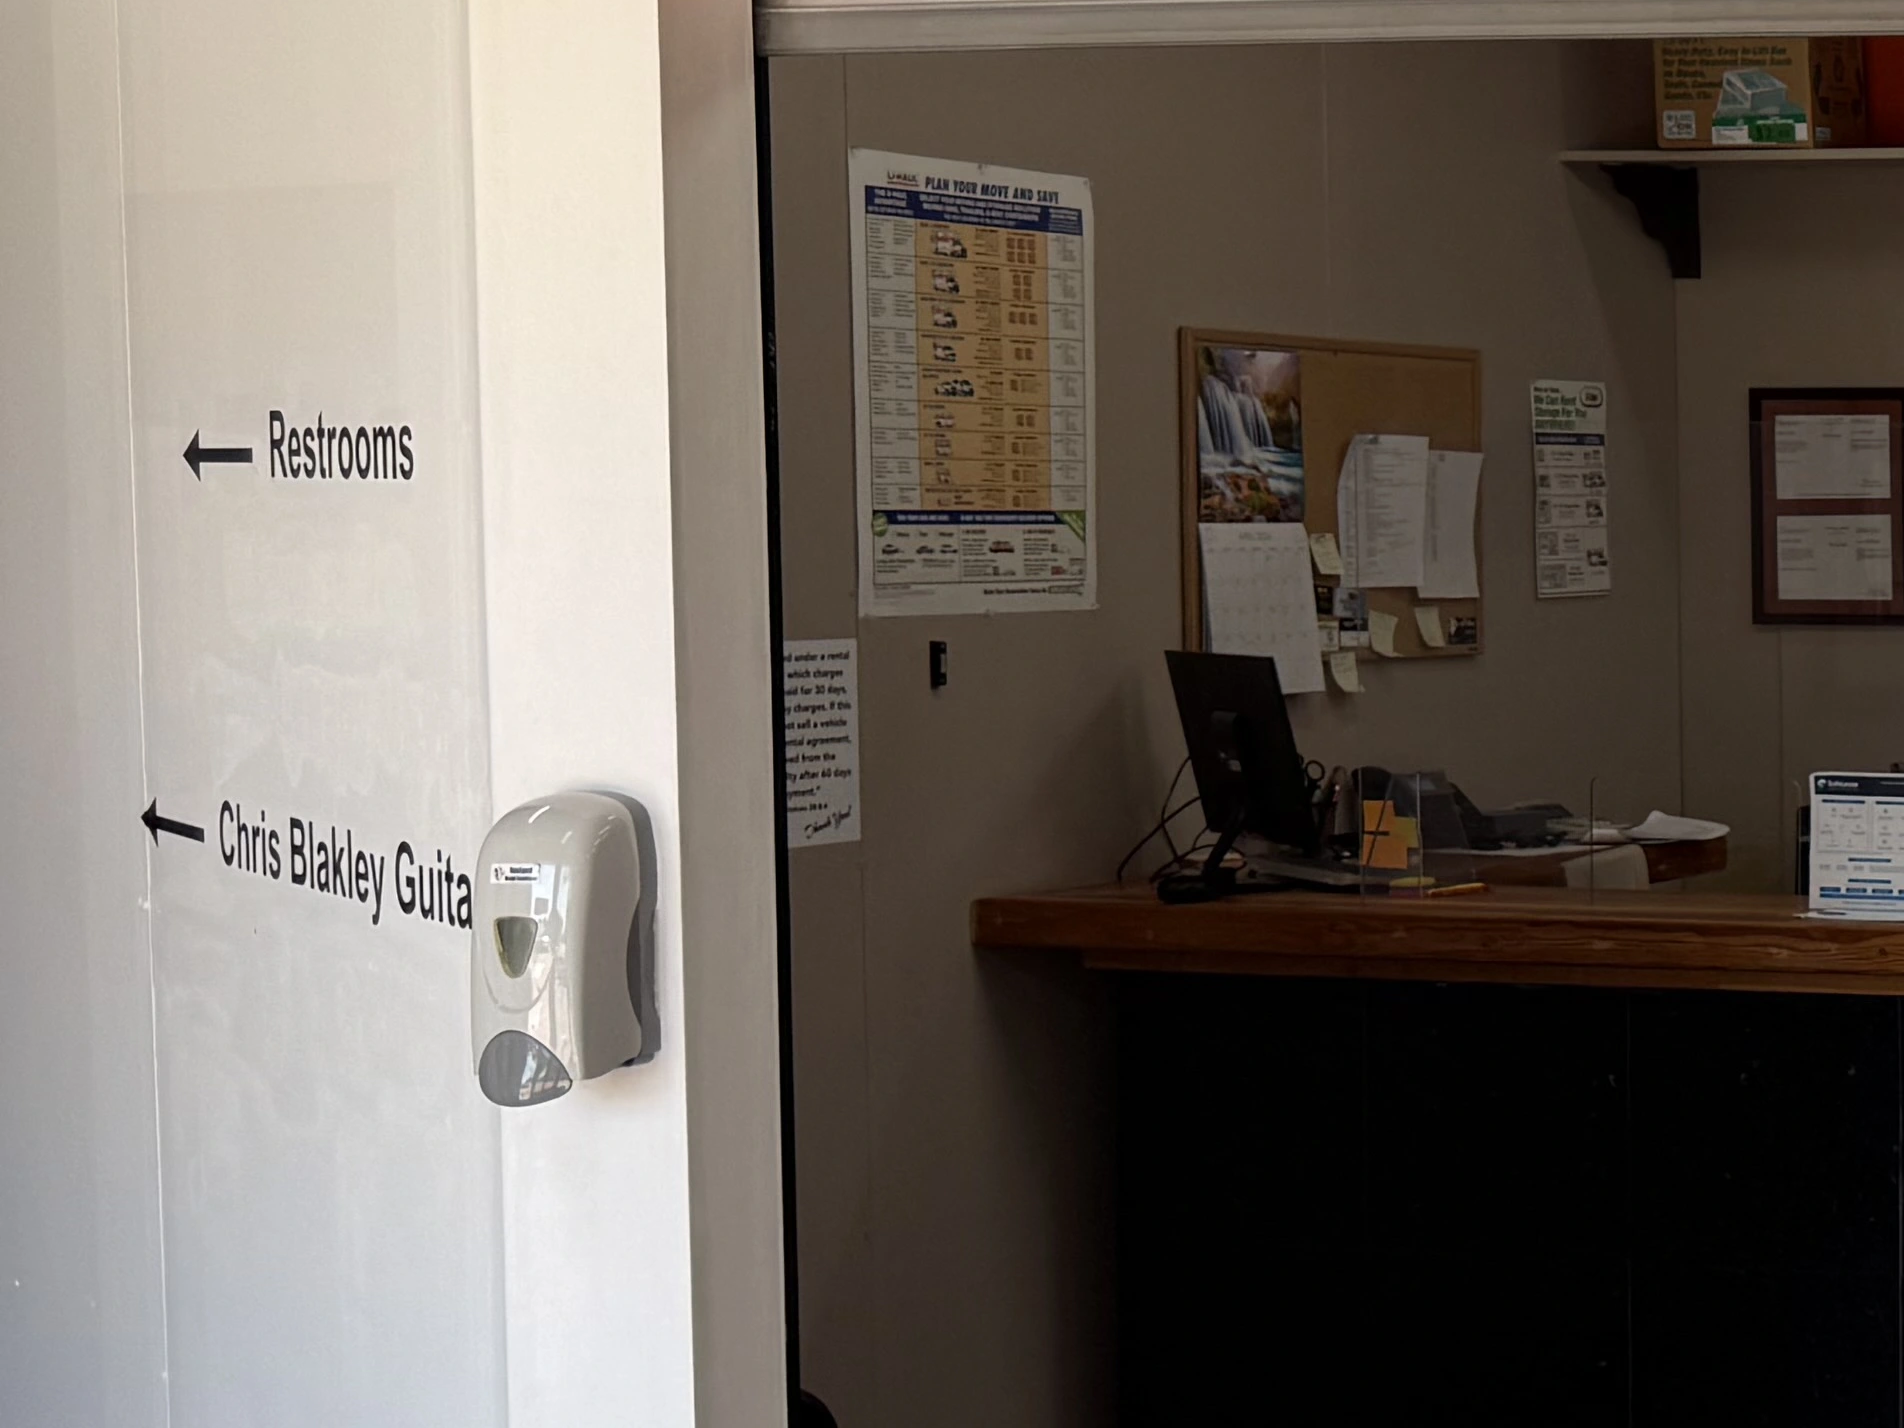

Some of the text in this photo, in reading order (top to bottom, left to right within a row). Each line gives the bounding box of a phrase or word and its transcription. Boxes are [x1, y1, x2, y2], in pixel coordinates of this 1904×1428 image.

[925, 175, 1060, 205] PLAN YOUR MOVE AND SAVE
[269, 410, 415, 480] Restrooms
[219, 799, 281, 881] Chris
[290, 816, 385, 926] Blakley
